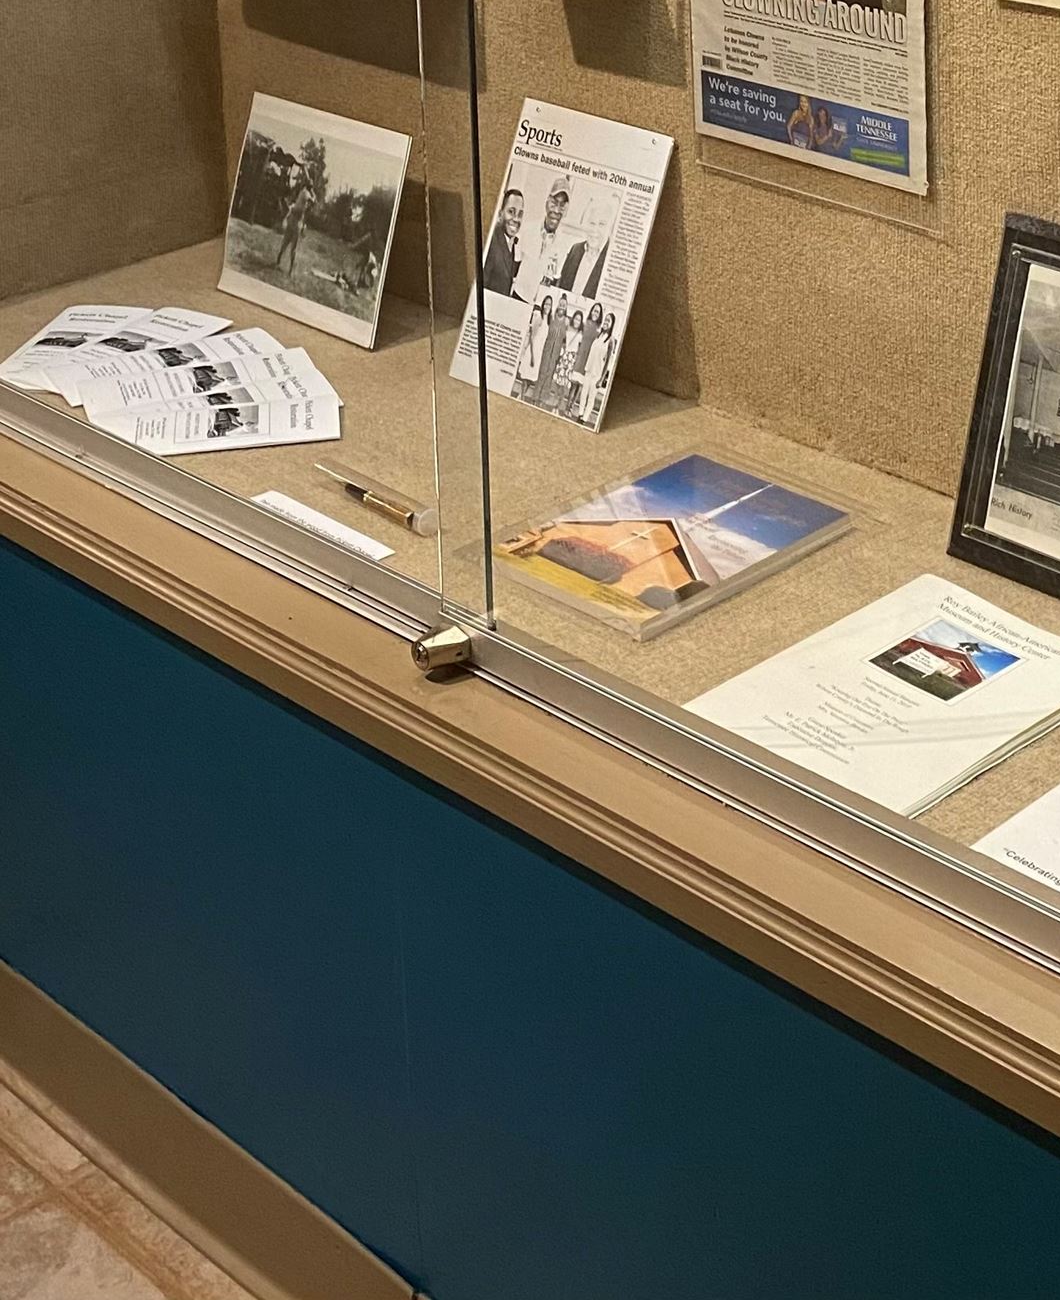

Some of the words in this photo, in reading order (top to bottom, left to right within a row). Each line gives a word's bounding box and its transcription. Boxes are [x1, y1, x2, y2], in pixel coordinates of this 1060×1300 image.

[708, 76, 740, 96] We're
[742, 88, 777, 108] saving
[709, 94, 717, 105] a
[718, 97, 742, 112] seat
[743, 100, 761, 116] for
[762, 108, 786, 124] you.
[860, 115, 892, 131] MIDDLE
[518, 119, 562, 146] Sports
[856, 124, 898, 142] TENNESSEE
[514, 146, 539, 161] Clowns
[540, 153, 571, 170] baseball
[571, 162, 591, 176] feted
[592, 170, 608, 181] with
[609, 173, 627, 186] 20th
[628, 181, 655, 194] annual
[944, 595, 962, 609] Roy
[938, 603, 972, 625] Museum
[973, 623, 990, 634] and
[989, 630, 1021, 650] History
[1021, 645, 1051, 660] Center
